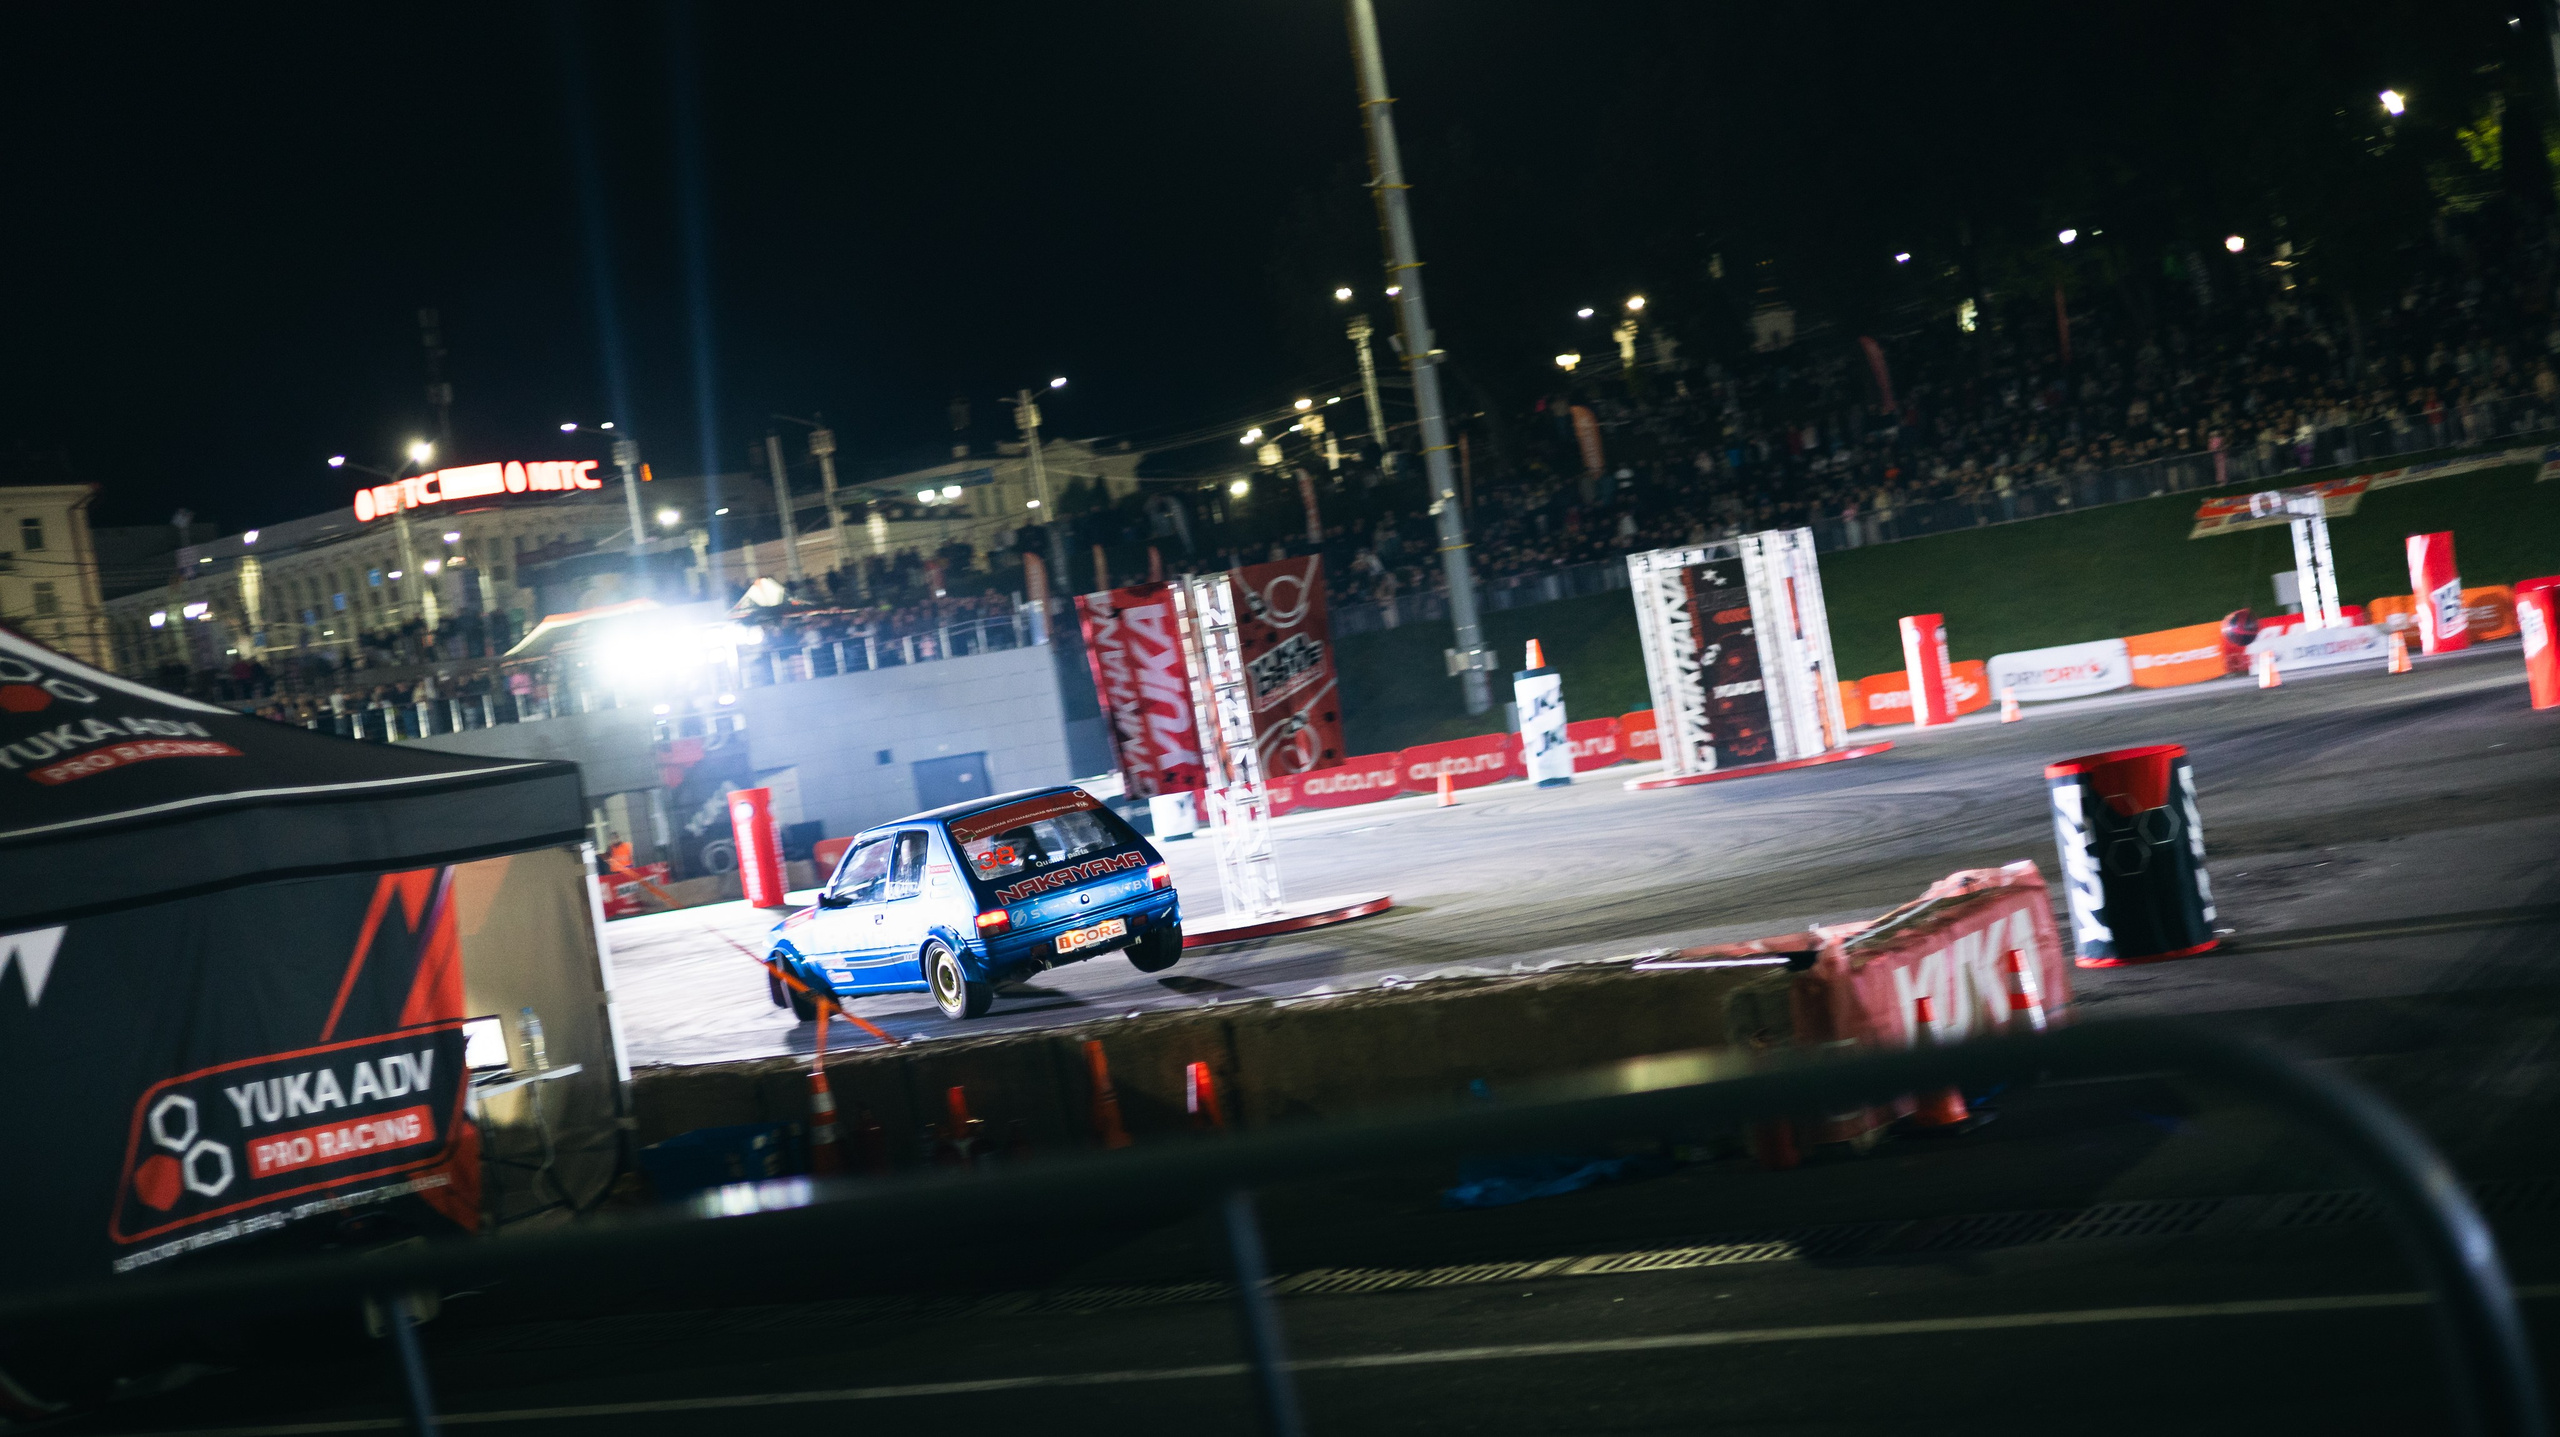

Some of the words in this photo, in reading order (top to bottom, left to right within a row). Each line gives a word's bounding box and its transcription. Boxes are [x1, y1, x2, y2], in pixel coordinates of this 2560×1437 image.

[1122, 603, 1201, 771] YUKA
[41, 753, 117, 781] PRO
[1408, 746, 1507, 781] auto.ru
[1304, 767, 1397, 796] auto.ru
[977, 846, 1017, 871] 38
[1067, 848, 1089, 860] parts
[995, 851, 1147, 905] NAKAYAMA
[223, 1068, 348, 1128] YUKA
[351, 1049, 434, 1105] ADV
[255, 1137, 314, 1172] PRO
[315, 1113, 422, 1159] RACING
